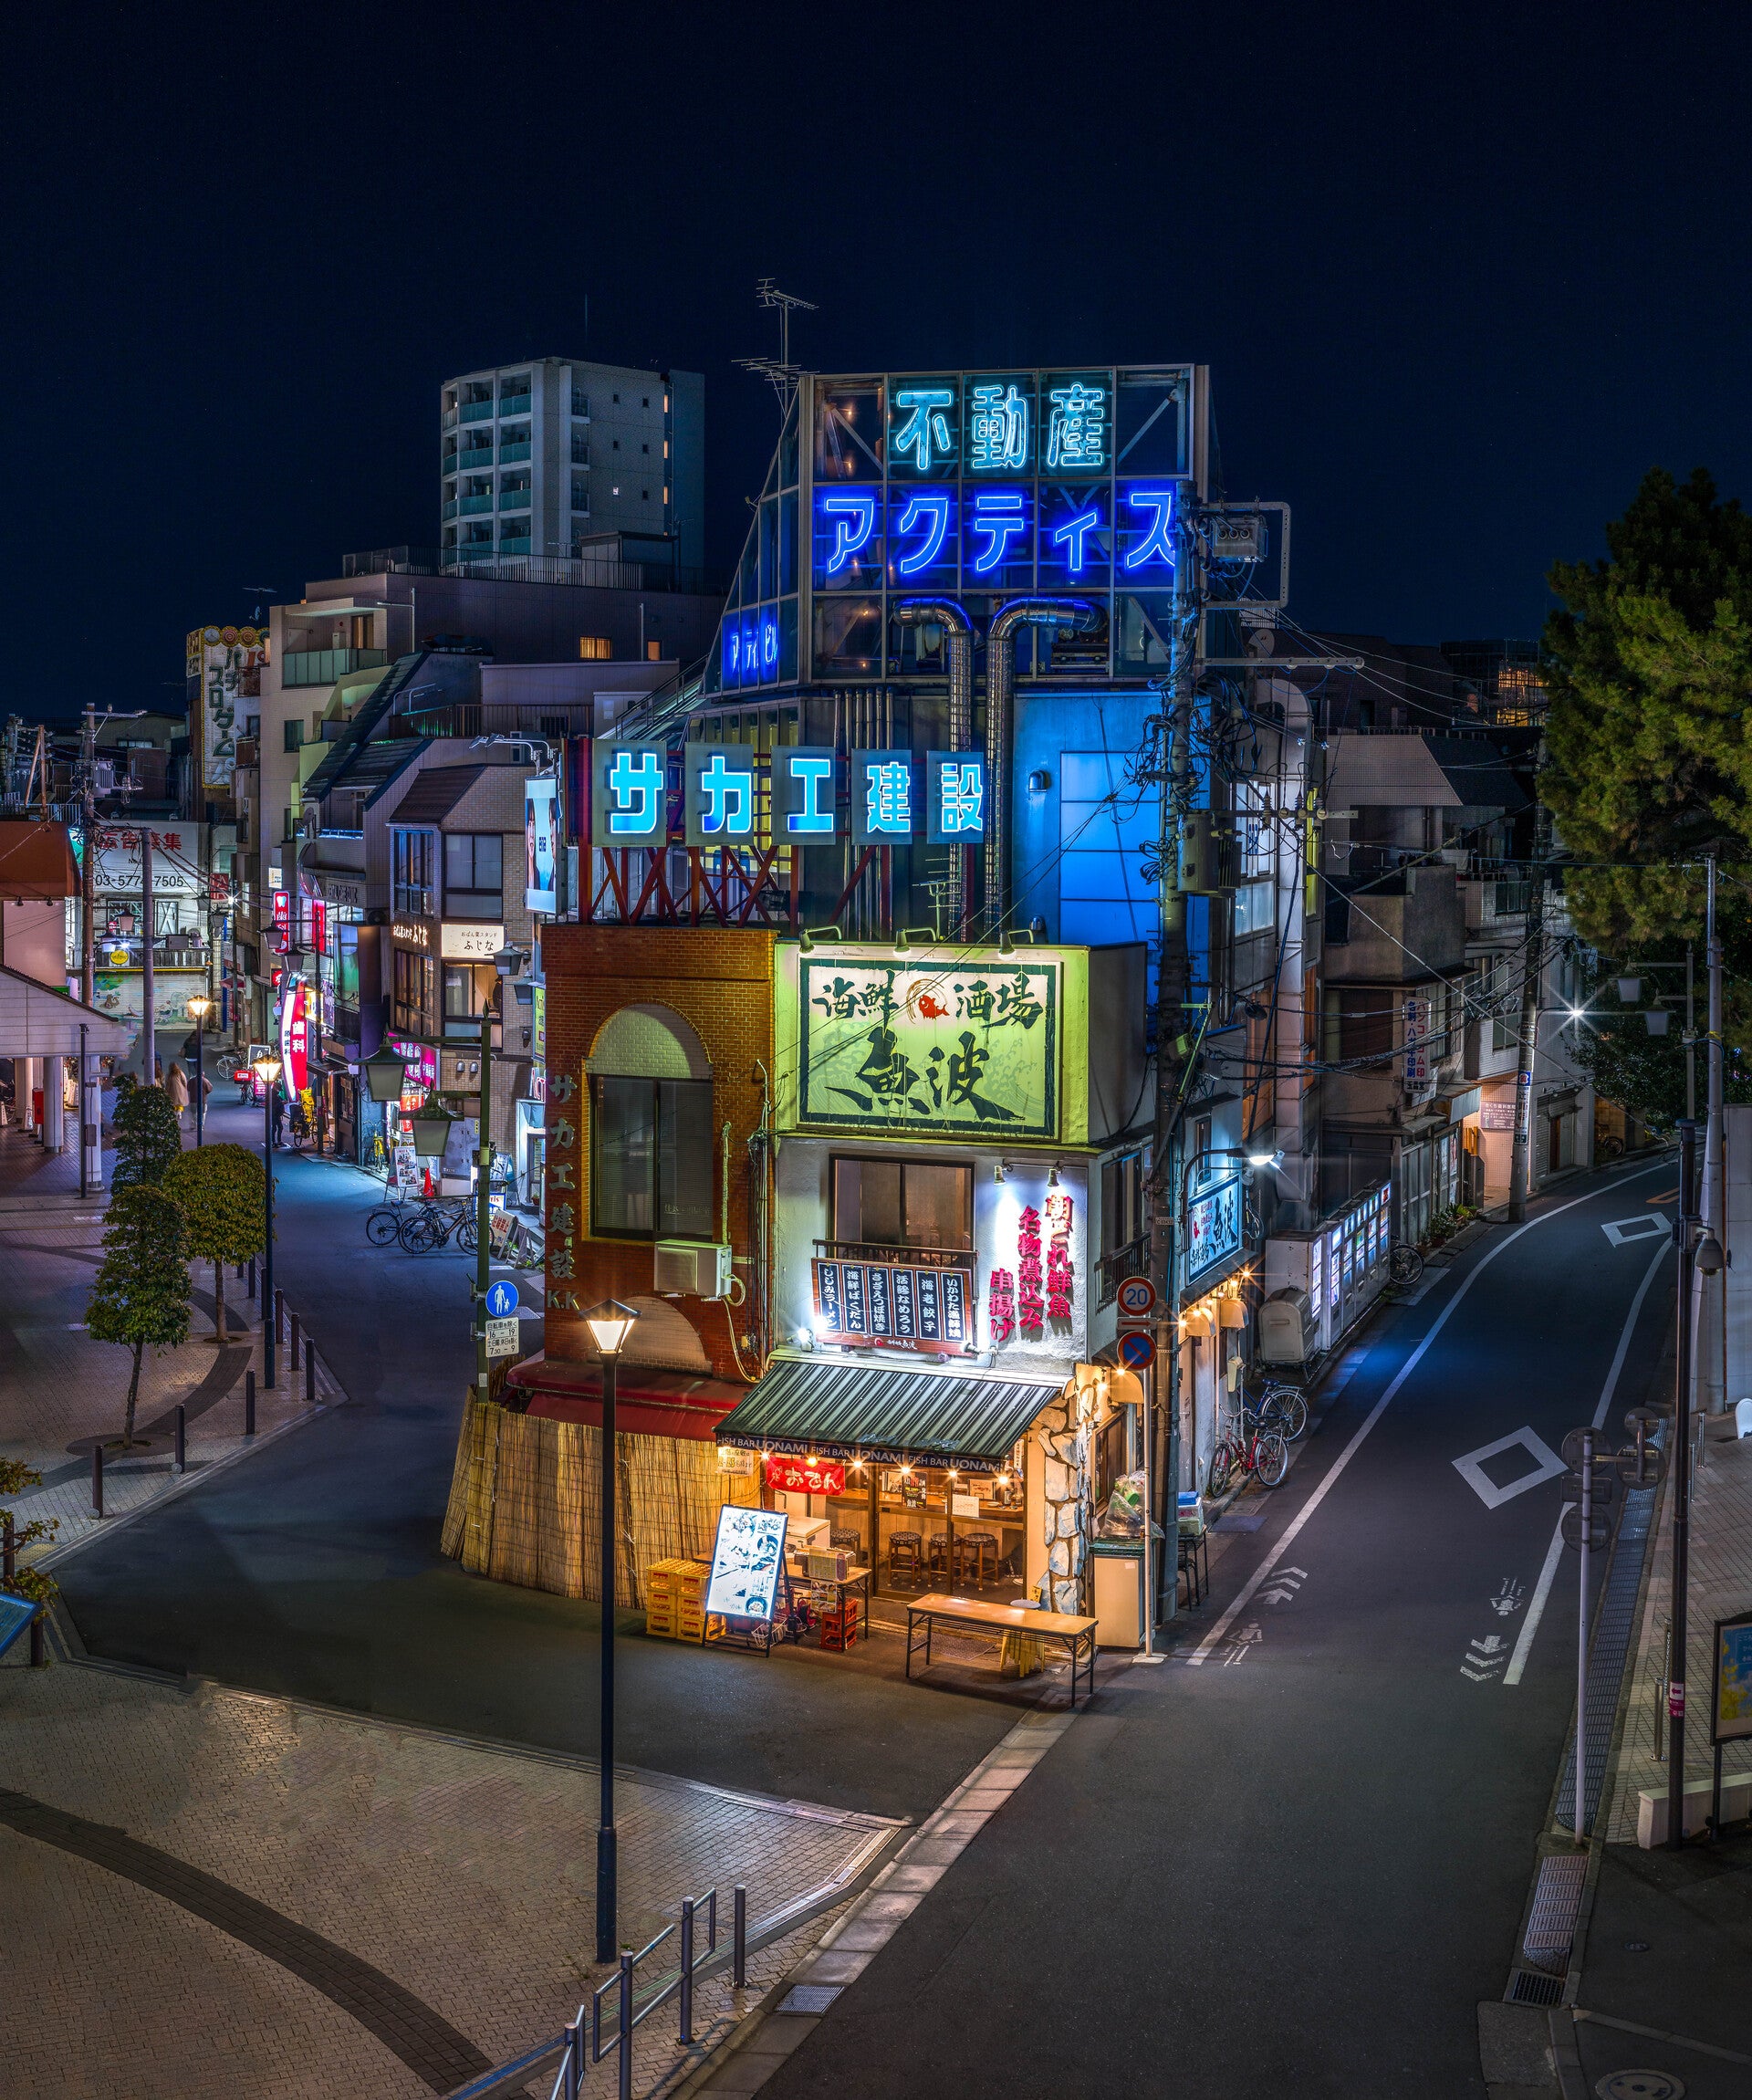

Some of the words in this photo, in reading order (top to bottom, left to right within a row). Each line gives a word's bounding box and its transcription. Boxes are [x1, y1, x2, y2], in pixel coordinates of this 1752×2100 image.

[895, 381, 1103, 472] 不動産
[825, 491, 1176, 575] アクティス
[610, 751, 984, 834] サカエ建設
[464, 940, 494, 951] ふじな
[811, 968, 900, 1030] 海鮮
[953, 970, 1044, 1030] 酒場
[825, 1026, 1026, 1122] 魚波
[548, 1073, 579, 1280] サカエ建設
[846, 1269, 861, 1330] 海鮮ばくだん
[1017, 1205, 1045, 1331] 名物煮込み
[1126, 1288, 1148, 1306] 20
[922, 1279, 936, 1332] 海老餃子
[988, 1268, 1016, 1342] 串揚げ
[737, 1439, 755, 1448] BAR
[756, 1439, 808, 1454] UONAMI
[811, 1446, 830, 1456] FISH
[832, 1449, 850, 1457] BAR
[851, 1448, 905, 1462] UONAMI
[930, 1457, 949, 1468] BAR
[785, 1467, 841, 1490] おでん
